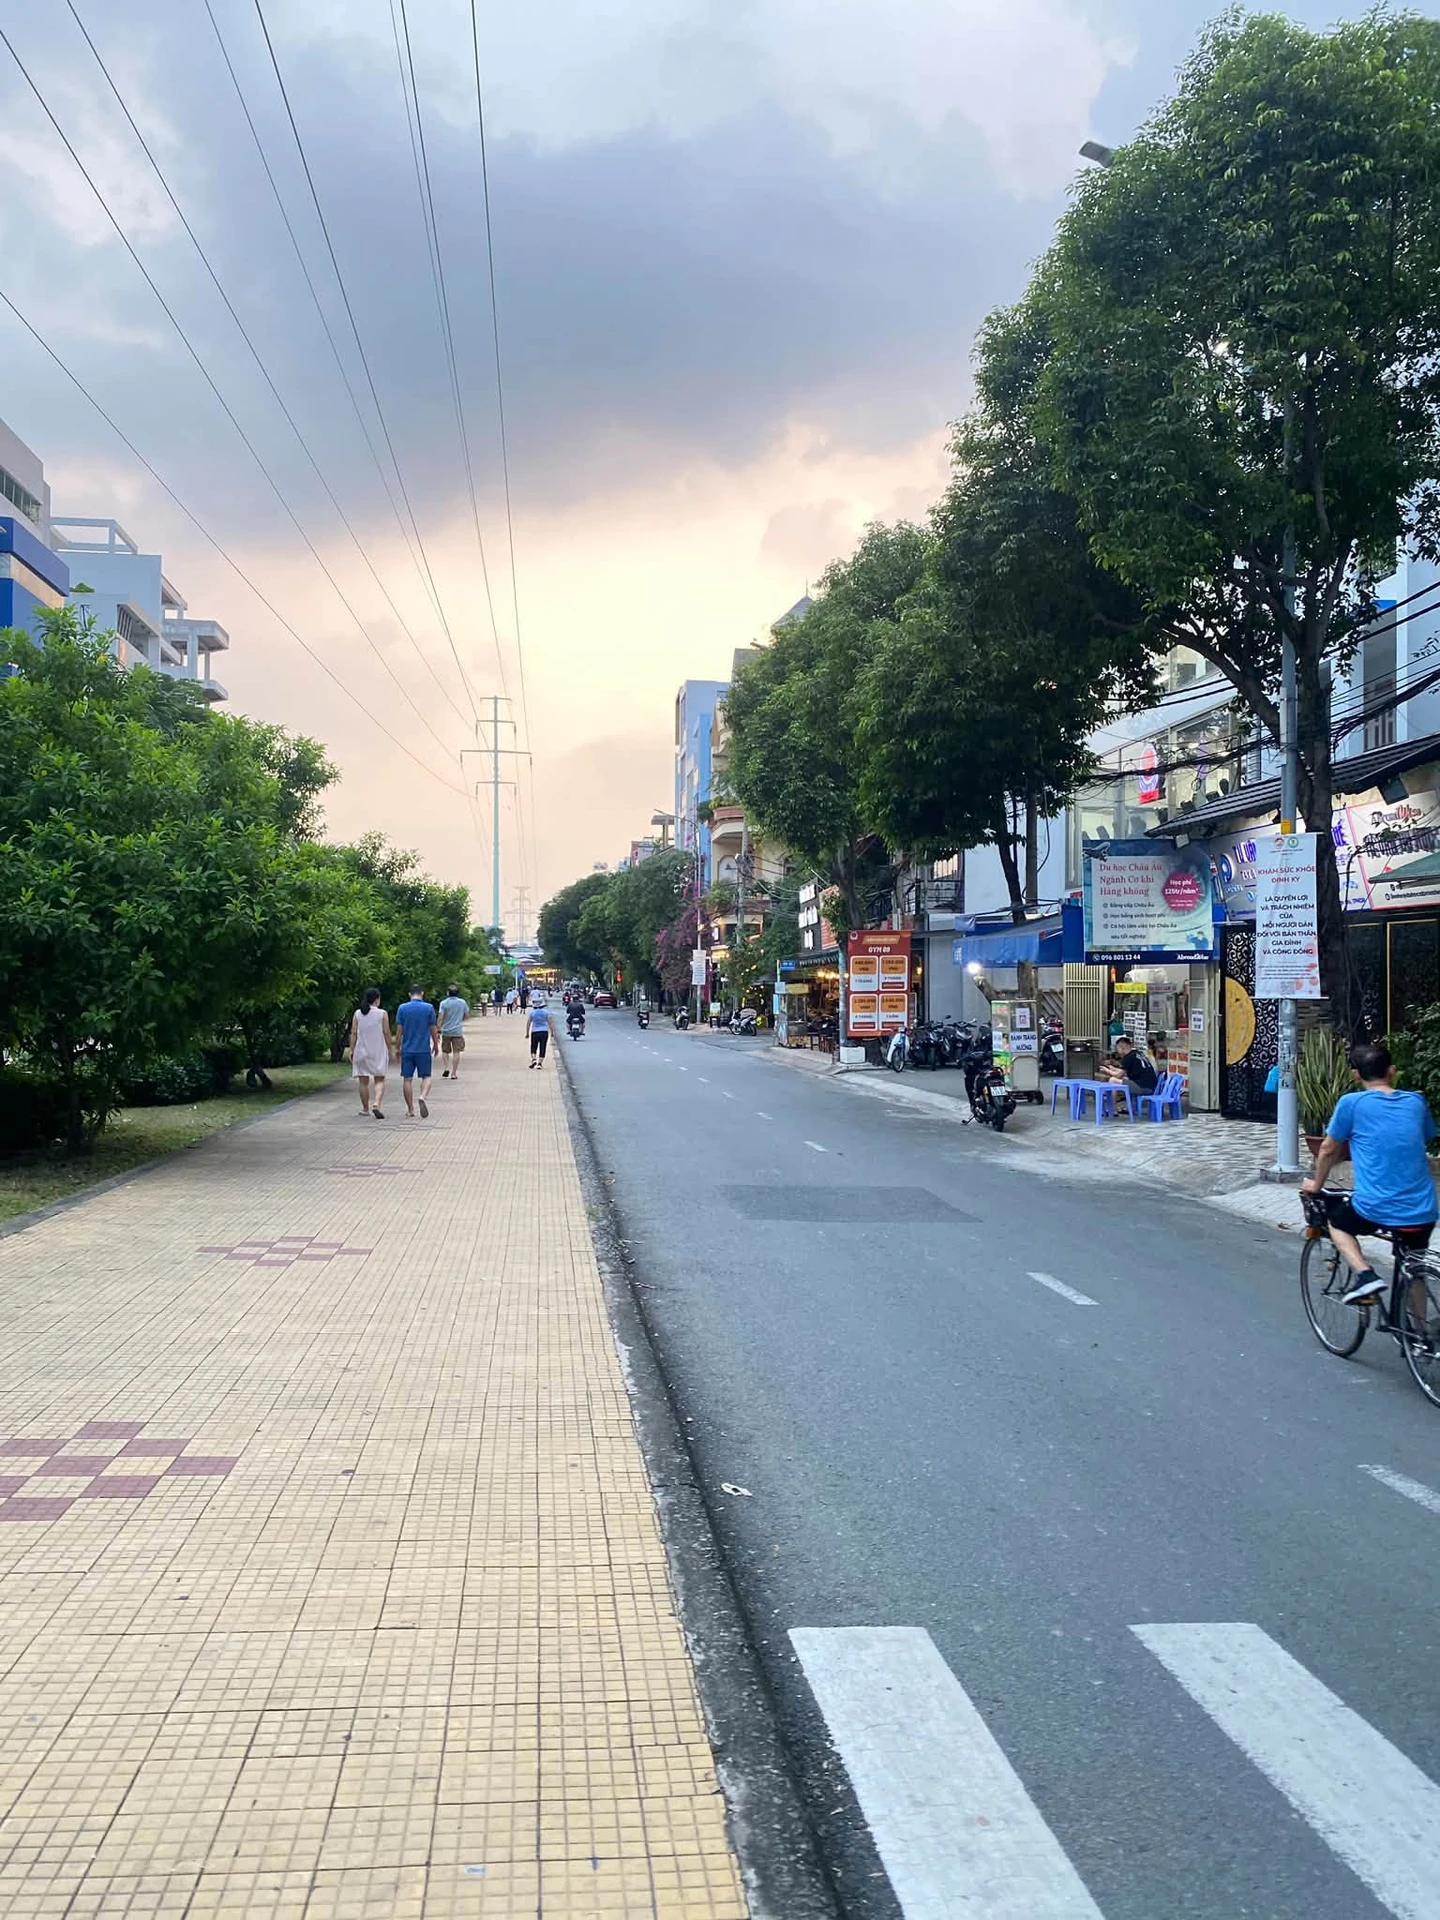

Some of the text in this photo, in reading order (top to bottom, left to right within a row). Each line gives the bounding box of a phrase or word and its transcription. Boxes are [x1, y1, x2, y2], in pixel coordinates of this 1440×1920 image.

[1258, 867, 1279, 876] KHÁM
[1279, 866, 1295, 874] SỨC
[1271, 877, 1290, 885] ĐỊNH
[1274, 894, 1297, 902] QUYỀN
[1297, 894, 1309, 902] LỢI
[1279, 911, 1294, 919] CỦA
[1257, 930, 1269, 938] ĐỐI
[1284, 938, 1302, 946] ĐÌNH
[1272, 947, 1292, 955] CỘNG
[1293, 946, 1313, 955] ĐỒNG
